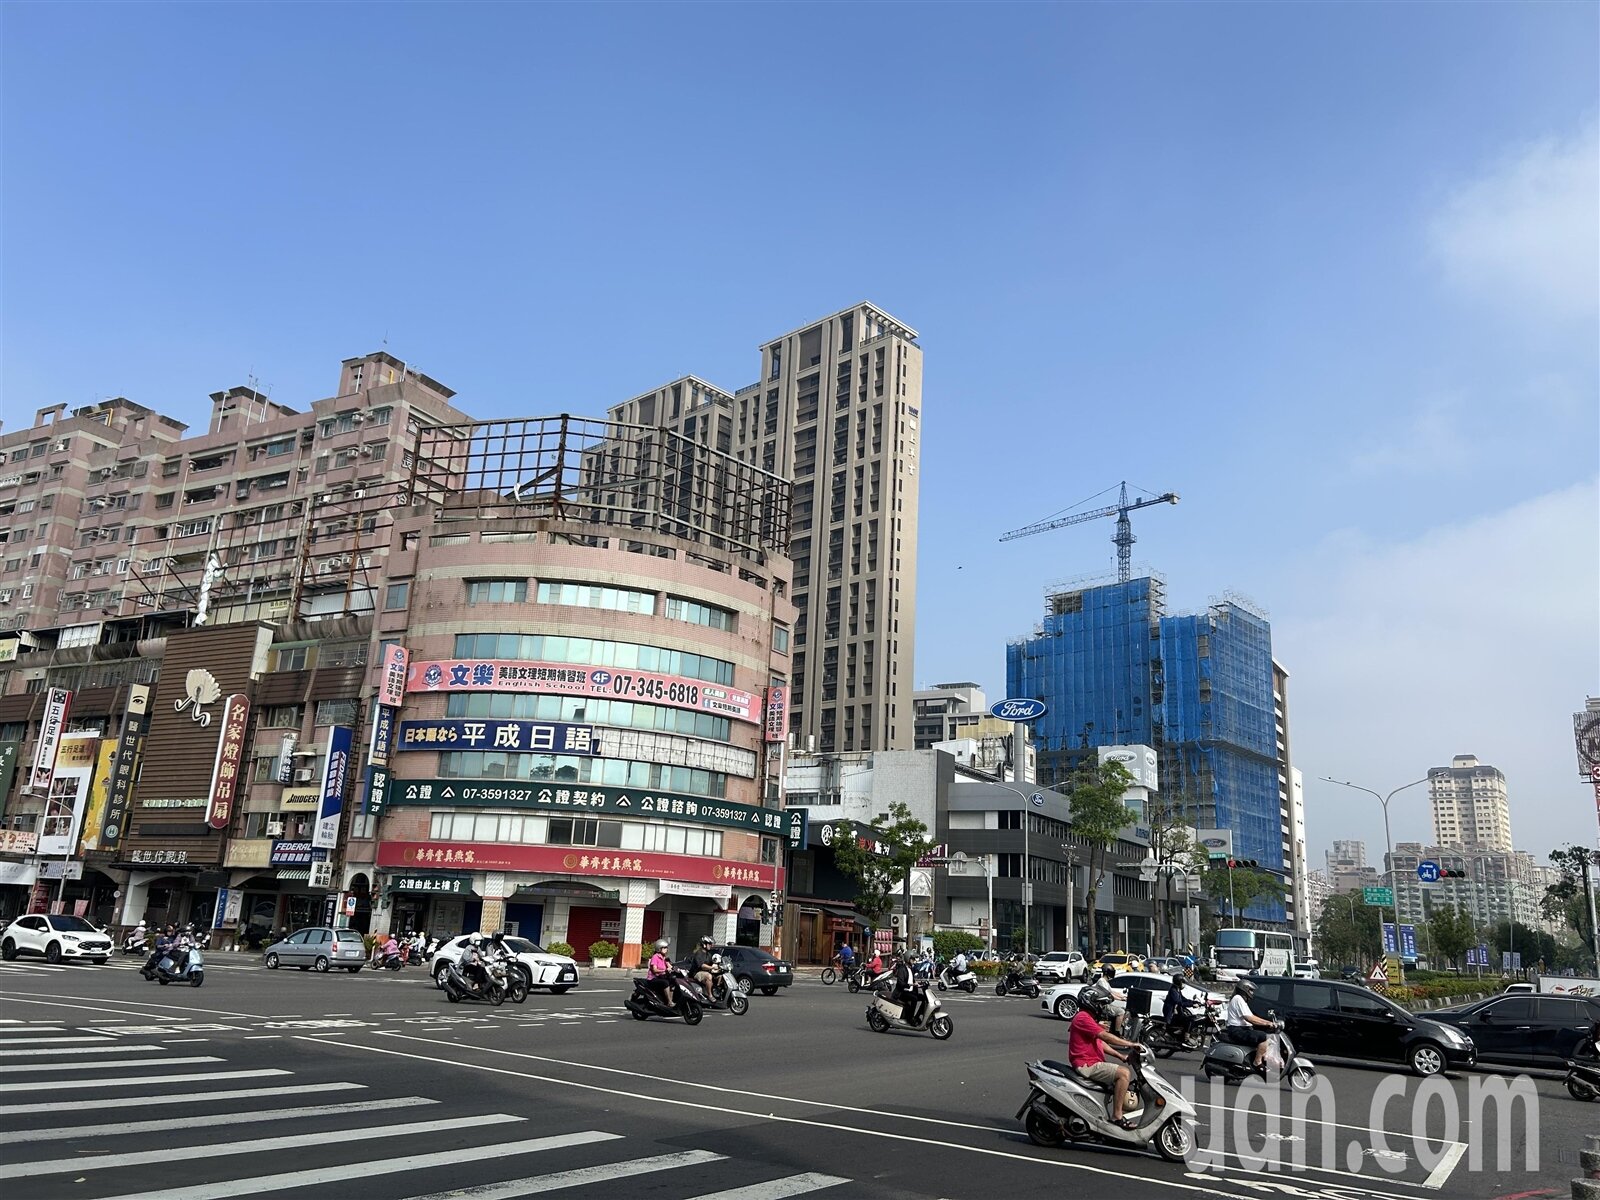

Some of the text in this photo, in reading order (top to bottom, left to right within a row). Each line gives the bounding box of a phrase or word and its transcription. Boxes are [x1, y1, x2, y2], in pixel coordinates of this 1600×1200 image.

[448, 664, 496, 686] 文樂
[498, 666, 587, 684] 美語文理短期補習班
[498, 681, 586, 691] English School
[592, 672, 609, 683] 4F
[590, 674, 698, 705] TEL: 07-345-6818
[1000, 701, 1034, 716] Ford
[377, 708, 390, 751] 平成外語
[461, 723, 591, 751] 平成日語
[109, 720, 139, 820] 醫世代眼科診所
[211, 703, 246, 820] 名家燈飾吊扇
[335, 751, 347, 797] FEDERAL
[371, 772, 386, 804] 認證
[371, 804, 380, 812] 2F
[405, 785, 782, 829] 公證 07-3591327 公證契約 公證諮詢 07-3591327 認證
[790, 812, 802, 839] 公證
[275, 842, 312, 850] FEDERAL
[314, 875, 330, 885] 輪胎
[399, 878, 451, 891] 公證由此上樓
